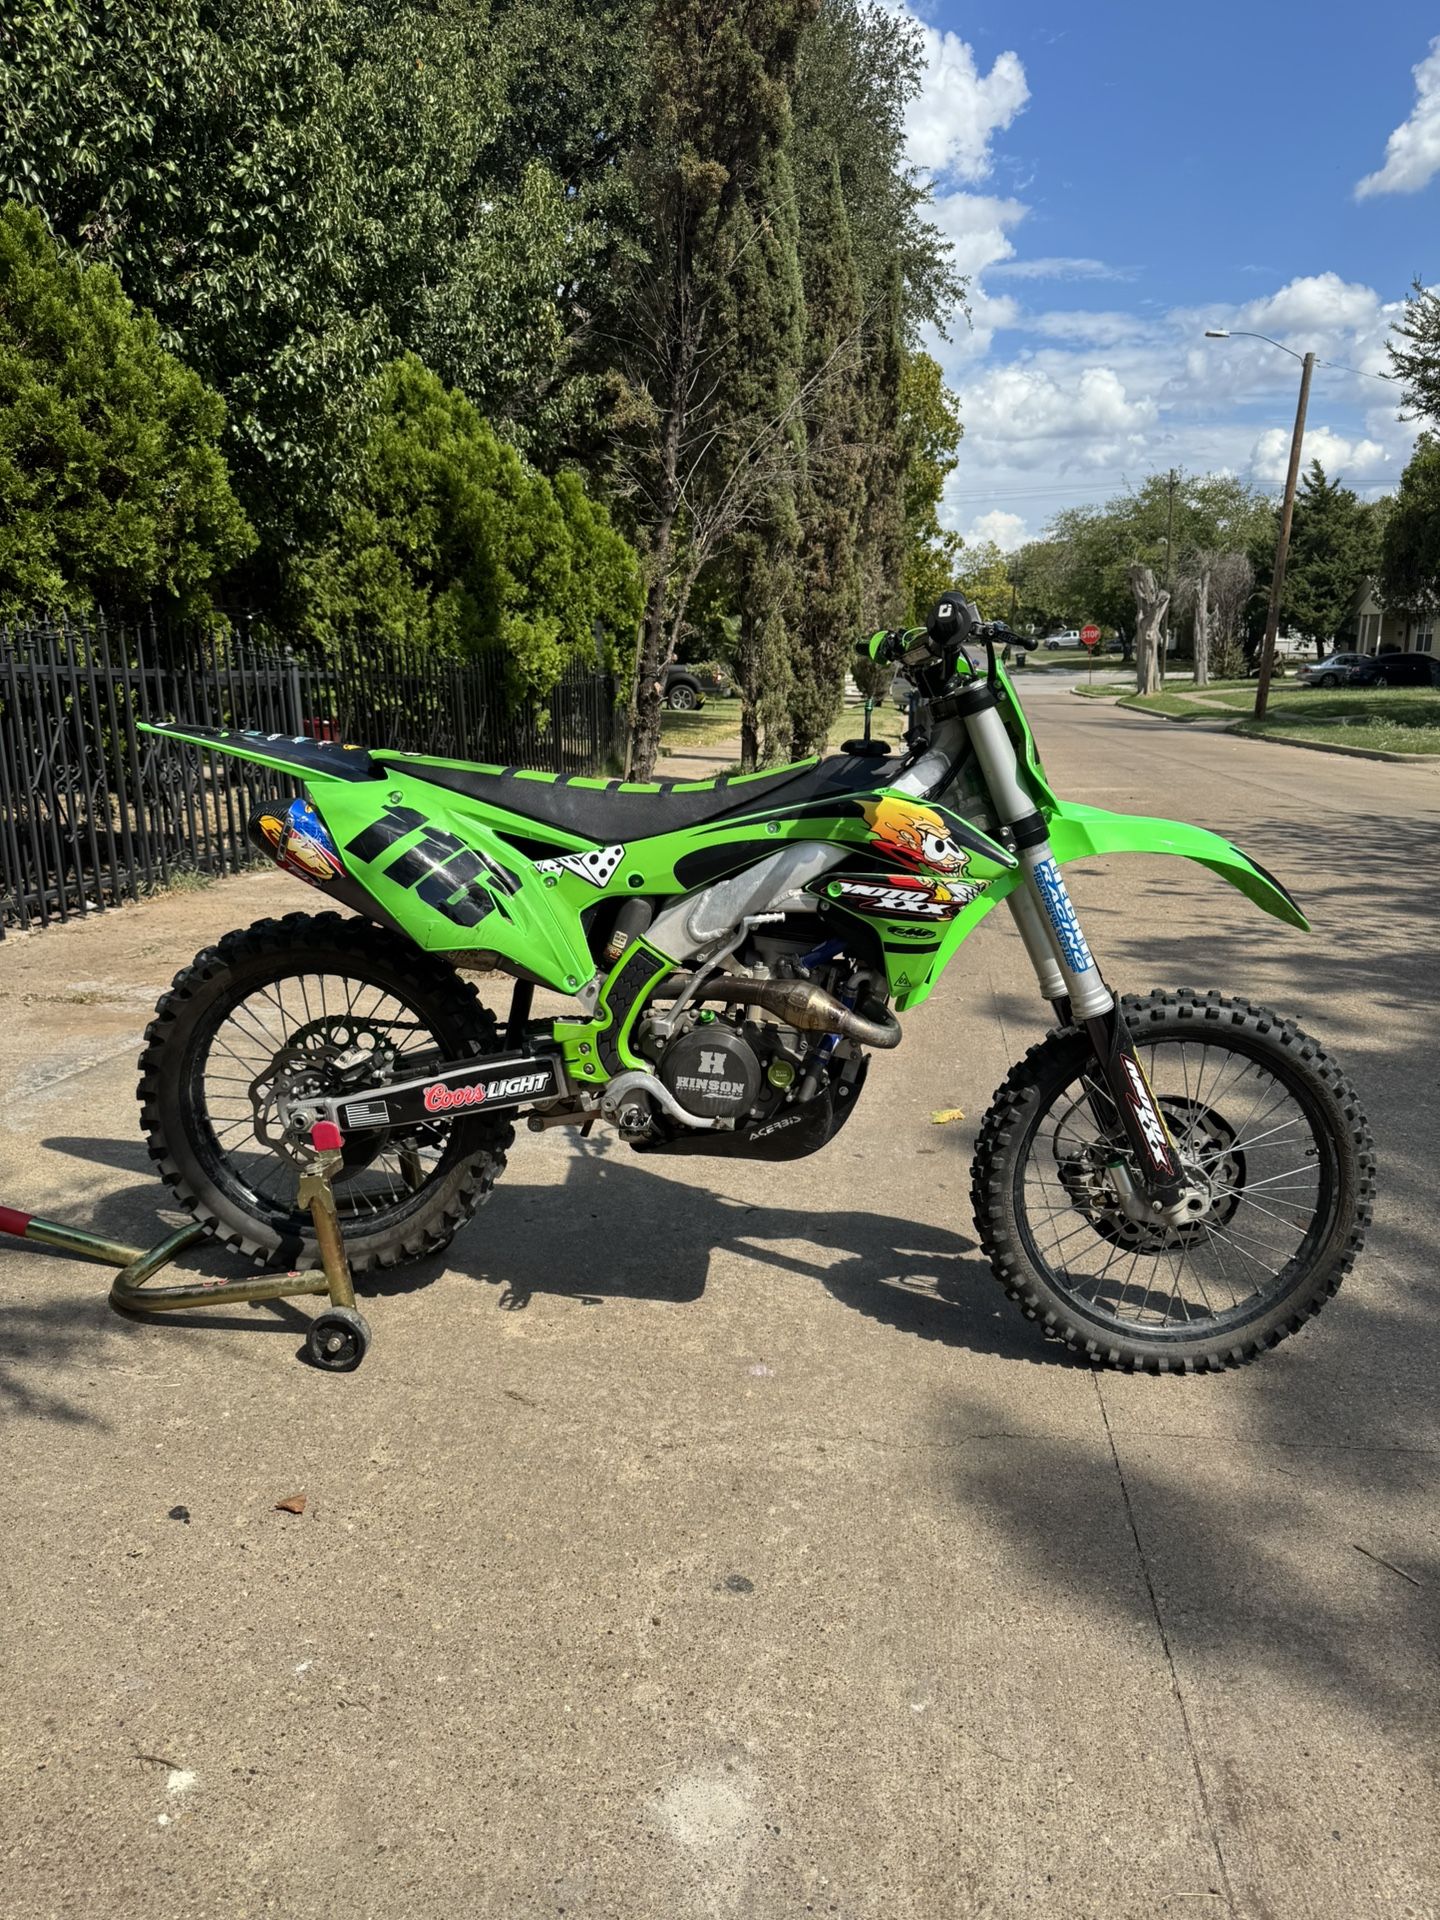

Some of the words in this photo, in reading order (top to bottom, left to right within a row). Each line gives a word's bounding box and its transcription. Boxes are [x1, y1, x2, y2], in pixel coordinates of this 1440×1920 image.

[1081, 630, 1100, 639] STOP
[839, 882, 933, 901] MOTO
[873, 897, 951, 915] XXX
[1032, 865, 1060, 928] SUSPENSION
[1056, 929, 1077, 973] SYSTEMS
[1039, 862, 1086, 970] RACING
[424, 1083, 487, 1112] Coors
[486, 1072, 551, 1100] LIGHT
[676, 1076, 745, 1093] HINSON
[1123, 1058, 1167, 1146] MOTO
[749, 1115, 802, 1141] ACERBIS
[1132, 1102, 1169, 1167] XXX
